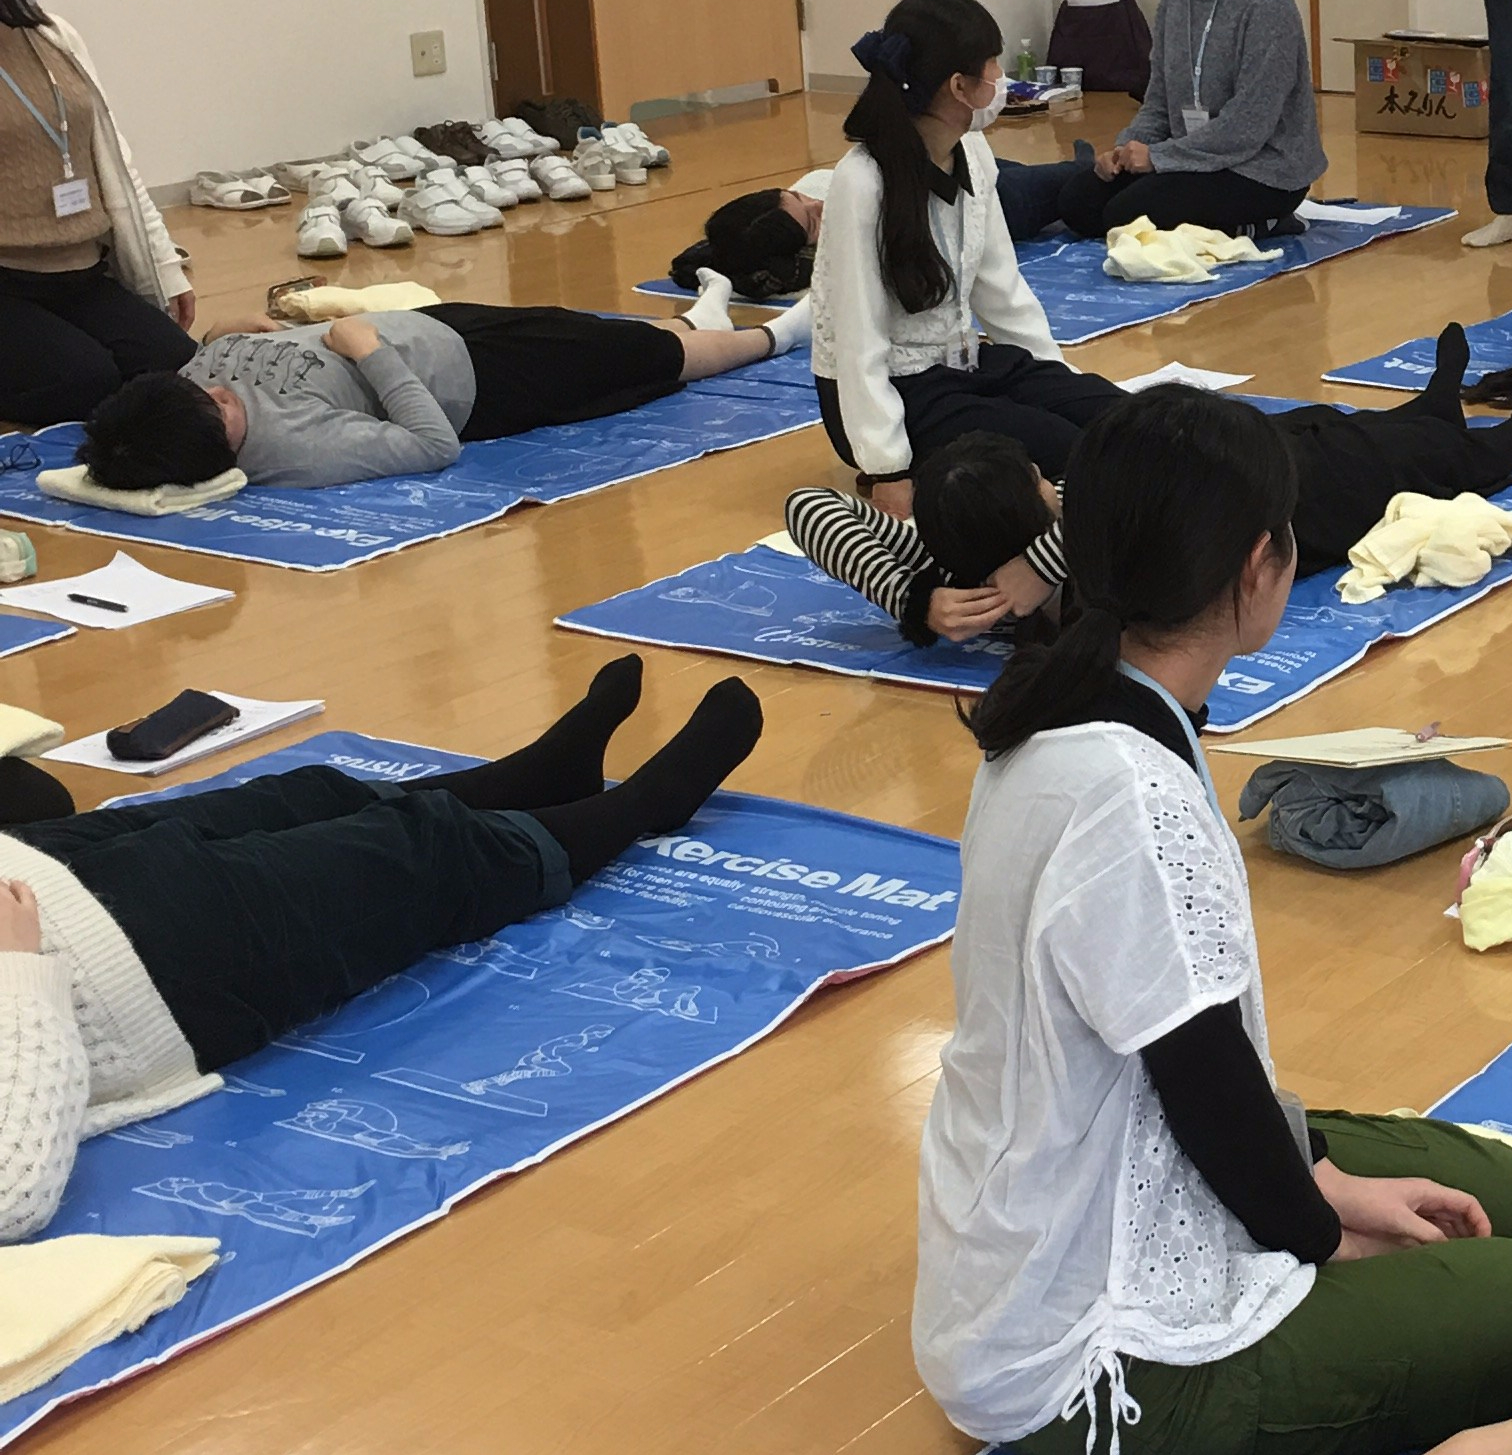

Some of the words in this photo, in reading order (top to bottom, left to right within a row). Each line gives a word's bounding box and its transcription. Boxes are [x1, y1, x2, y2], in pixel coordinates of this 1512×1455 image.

[1376, 85, 1457, 120] 本みりん
[636, 835, 841, 889] xercise
[836, 873, 959, 912] Mat
[698, 874, 746, 892] equally
